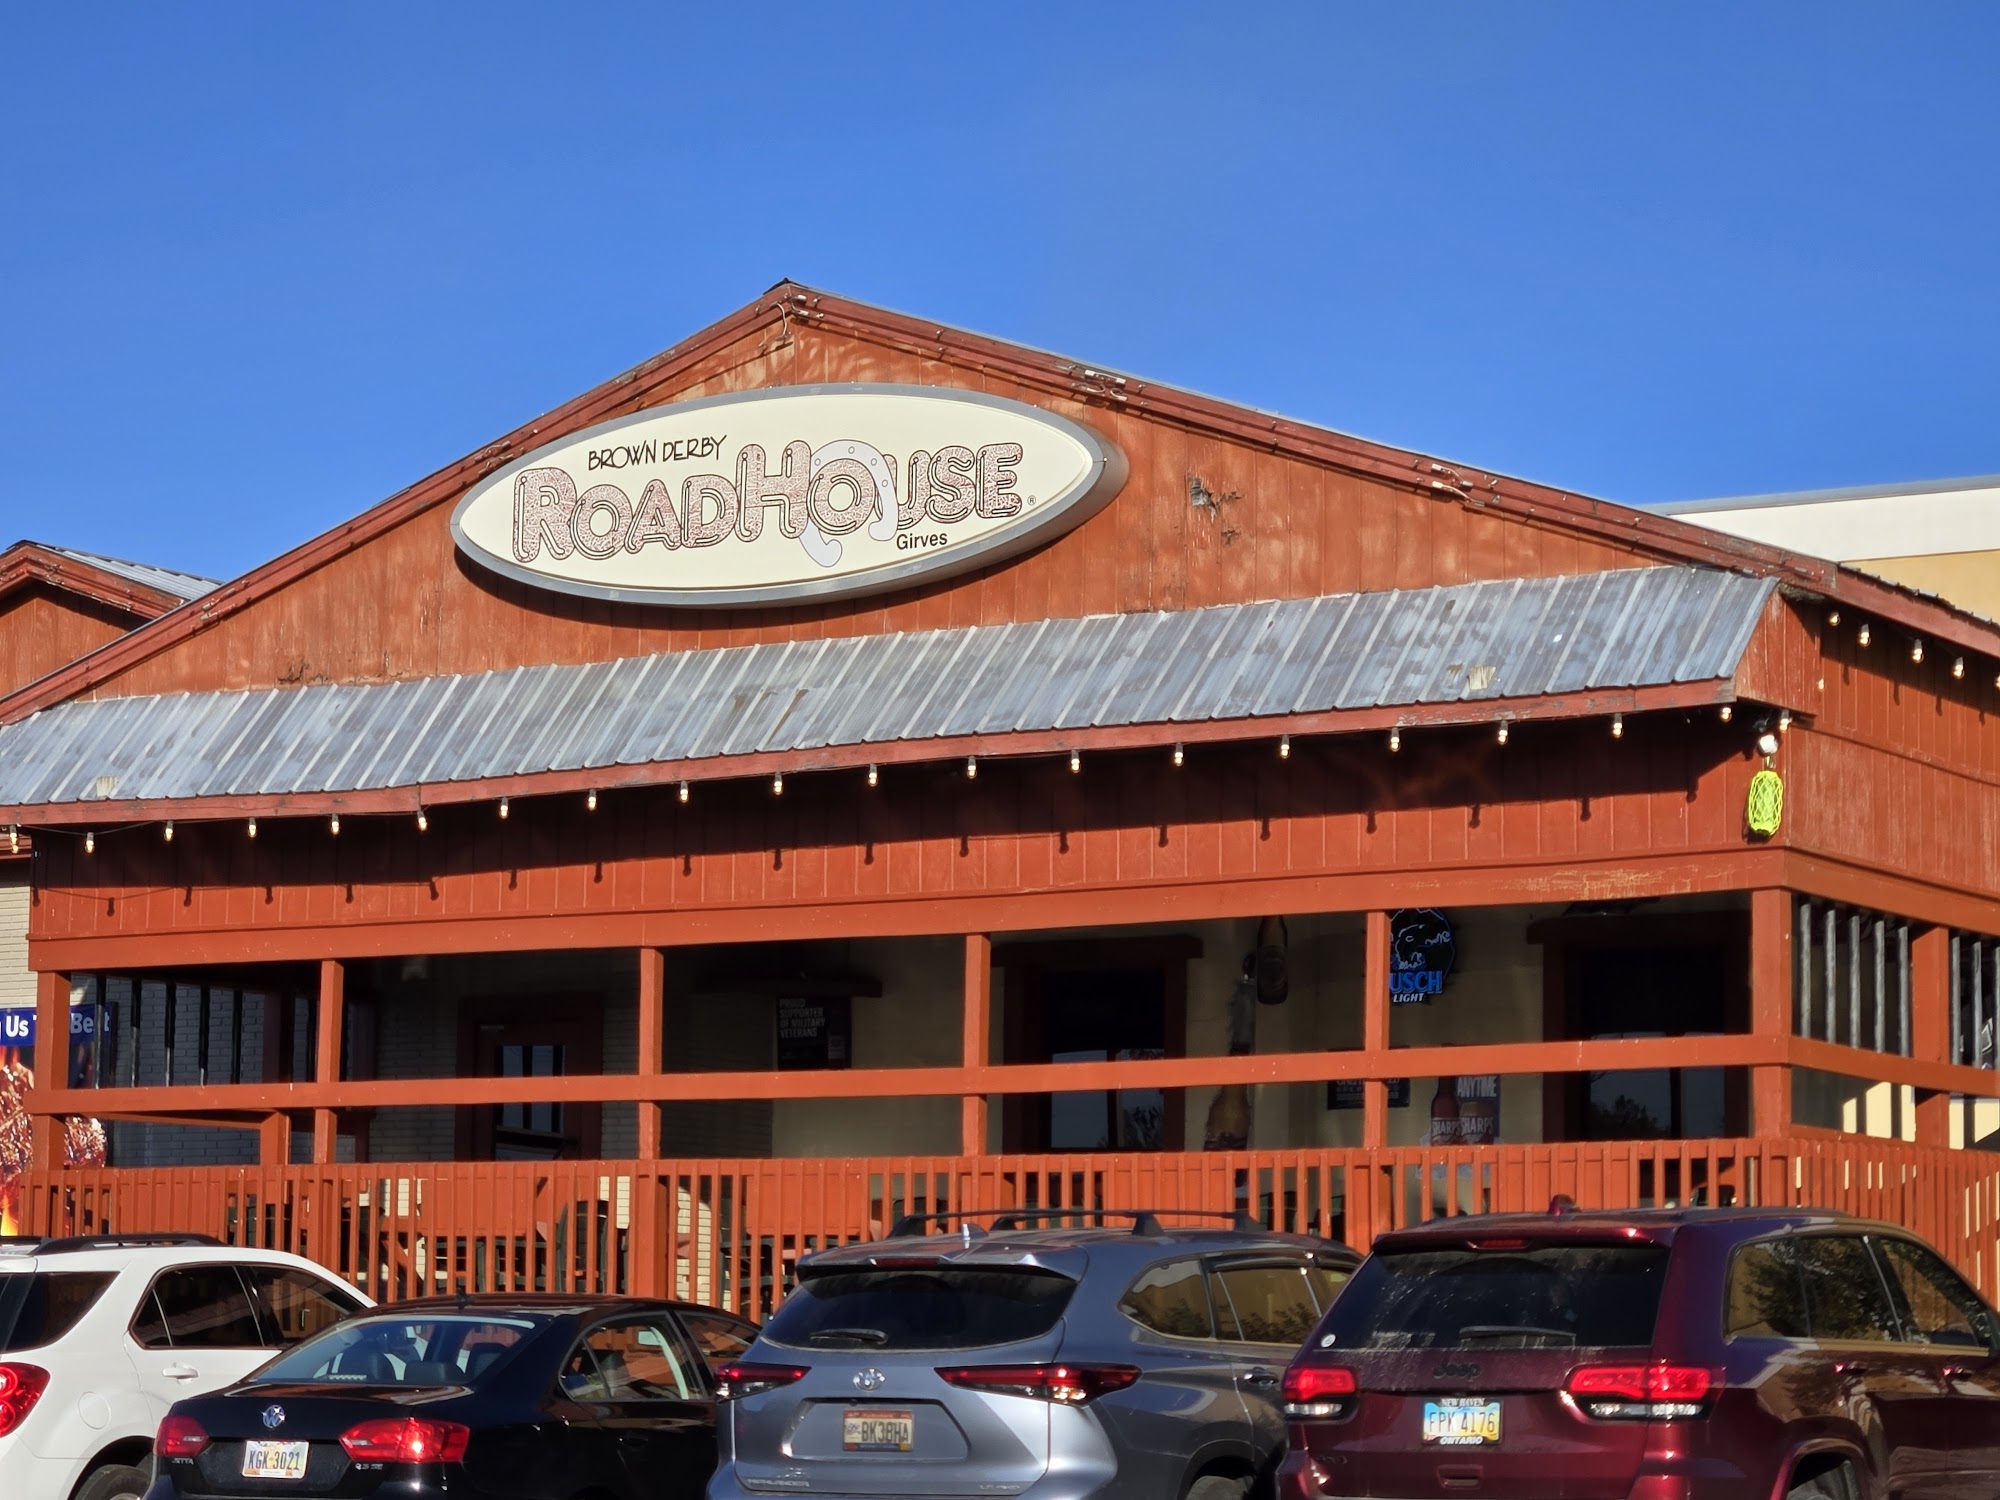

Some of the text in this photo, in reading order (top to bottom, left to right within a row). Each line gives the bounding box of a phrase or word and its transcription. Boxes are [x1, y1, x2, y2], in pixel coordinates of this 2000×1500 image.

[588, 434, 728, 471] BROWN DERBY
[896, 532, 948, 550] Girves
[1388, 970, 1443, 994] USCH
[779, 998, 806, 1008] PROUD
[1393, 993, 1425, 1003] LIGHT
[779, 1007, 824, 1018] SUPPORTER
[5, 1011, 110, 1038] Us Bet
[780, 1017, 826, 1028] OF MILITARY
[780, 1027, 818, 1039] VETERANS
[1457, 1076, 1497, 1098] ANYTIME
[1461, 1411, 1495, 1433] 4176
[1440, 1436, 1484, 1445] ONTARIO
[248, 1450, 300, 1471] KGK 3021
